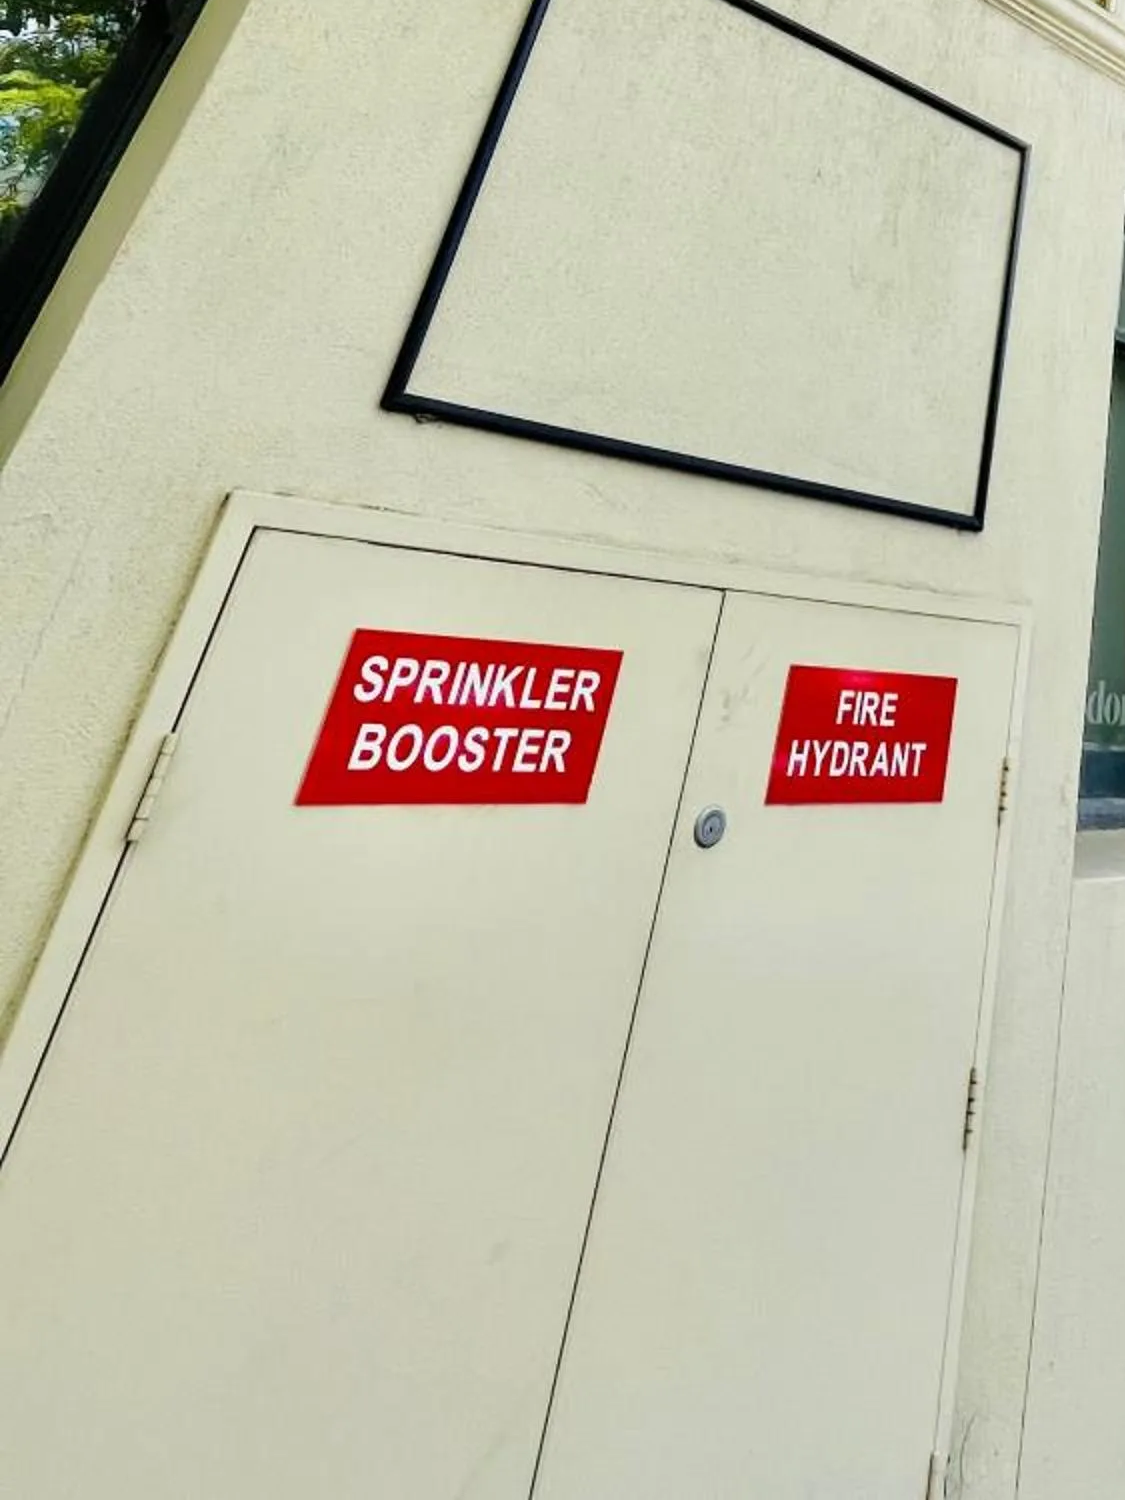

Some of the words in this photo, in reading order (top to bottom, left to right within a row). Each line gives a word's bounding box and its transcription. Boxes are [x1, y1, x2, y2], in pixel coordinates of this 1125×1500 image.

[352, 654, 602, 712] SPRINKLER
[835, 688, 899, 728] FIRE
[347, 722, 572, 773] BOOSTER
[786, 739, 927, 778] HYDRANT
